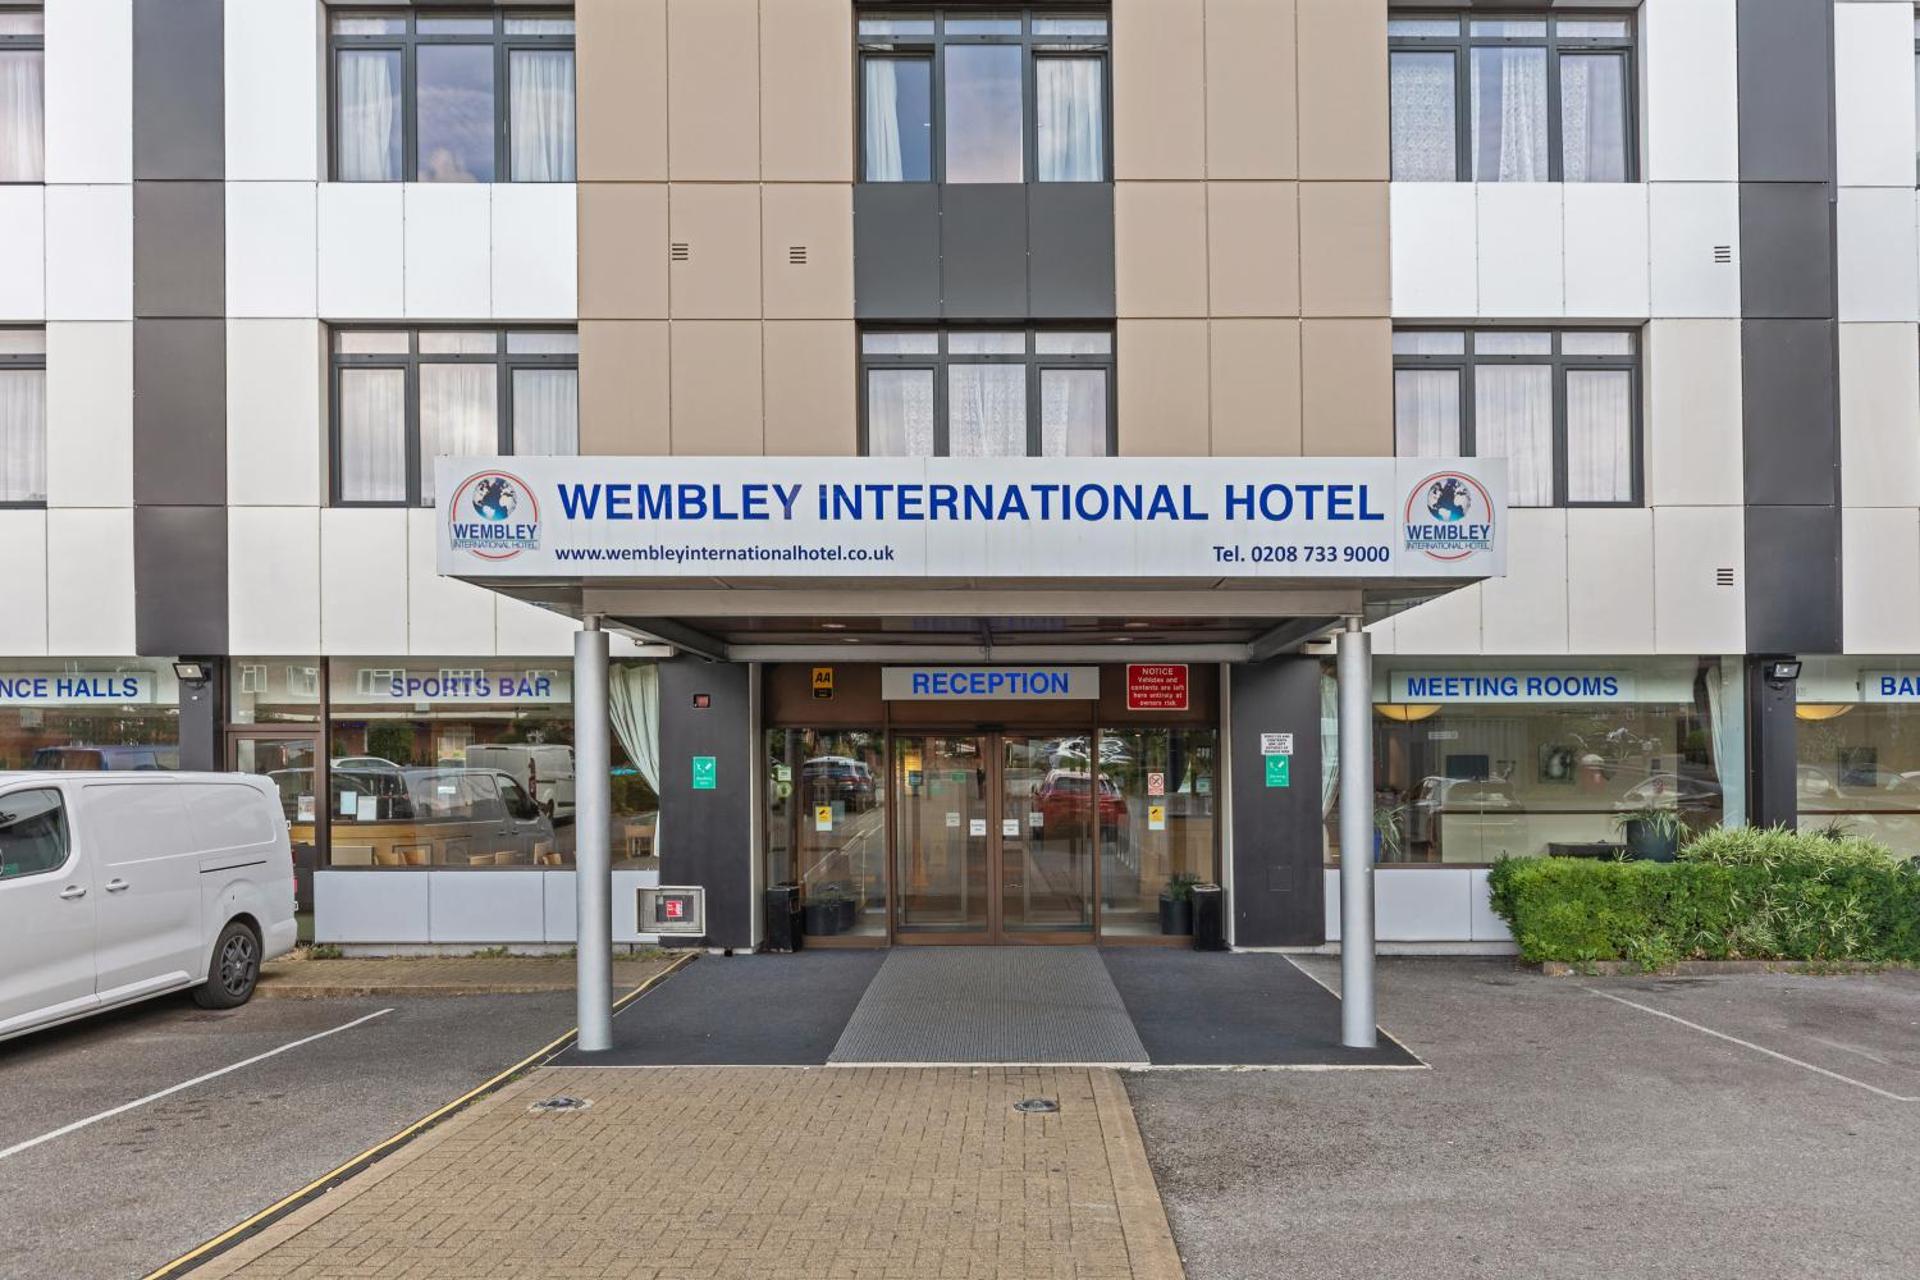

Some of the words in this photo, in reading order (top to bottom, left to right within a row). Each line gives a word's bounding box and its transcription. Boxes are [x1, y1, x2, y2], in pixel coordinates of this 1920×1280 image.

[557, 484, 803, 520] WEMBLEY
[819, 483, 1208, 521] INTERNATIONAL
[1226, 484, 1384, 521] HOTEL
[453, 524, 537, 539] WEMBLEY
[1407, 525, 1490, 540] WEMBLEY
[453, 541, 510, 549] INTERNATIONAL
[512, 541, 537, 550] HOTEL
[1213, 545, 1245, 562] Tel.
[1252, 546, 1297, 562] 0208
[1304, 546, 1337, 562] 733
[1344, 546, 1389, 562] 9000
[1406, 542, 1464, 550] INTERNATIONAL
[1465, 542, 1490, 550] HOTEL
[555, 545, 895, 564] www.wembleyinternationalhotel.co.uk
[815, 672, 830, 682] AA
[913, 672, 1068, 694] RECEPTION
[56, 678, 138, 697] HALLS
[390, 678, 491, 696] SPORTS
[499, 678, 550, 696] BAR
[1408, 677, 1517, 696] MEETING
[1528, 676, 1618, 696] ROOMS
